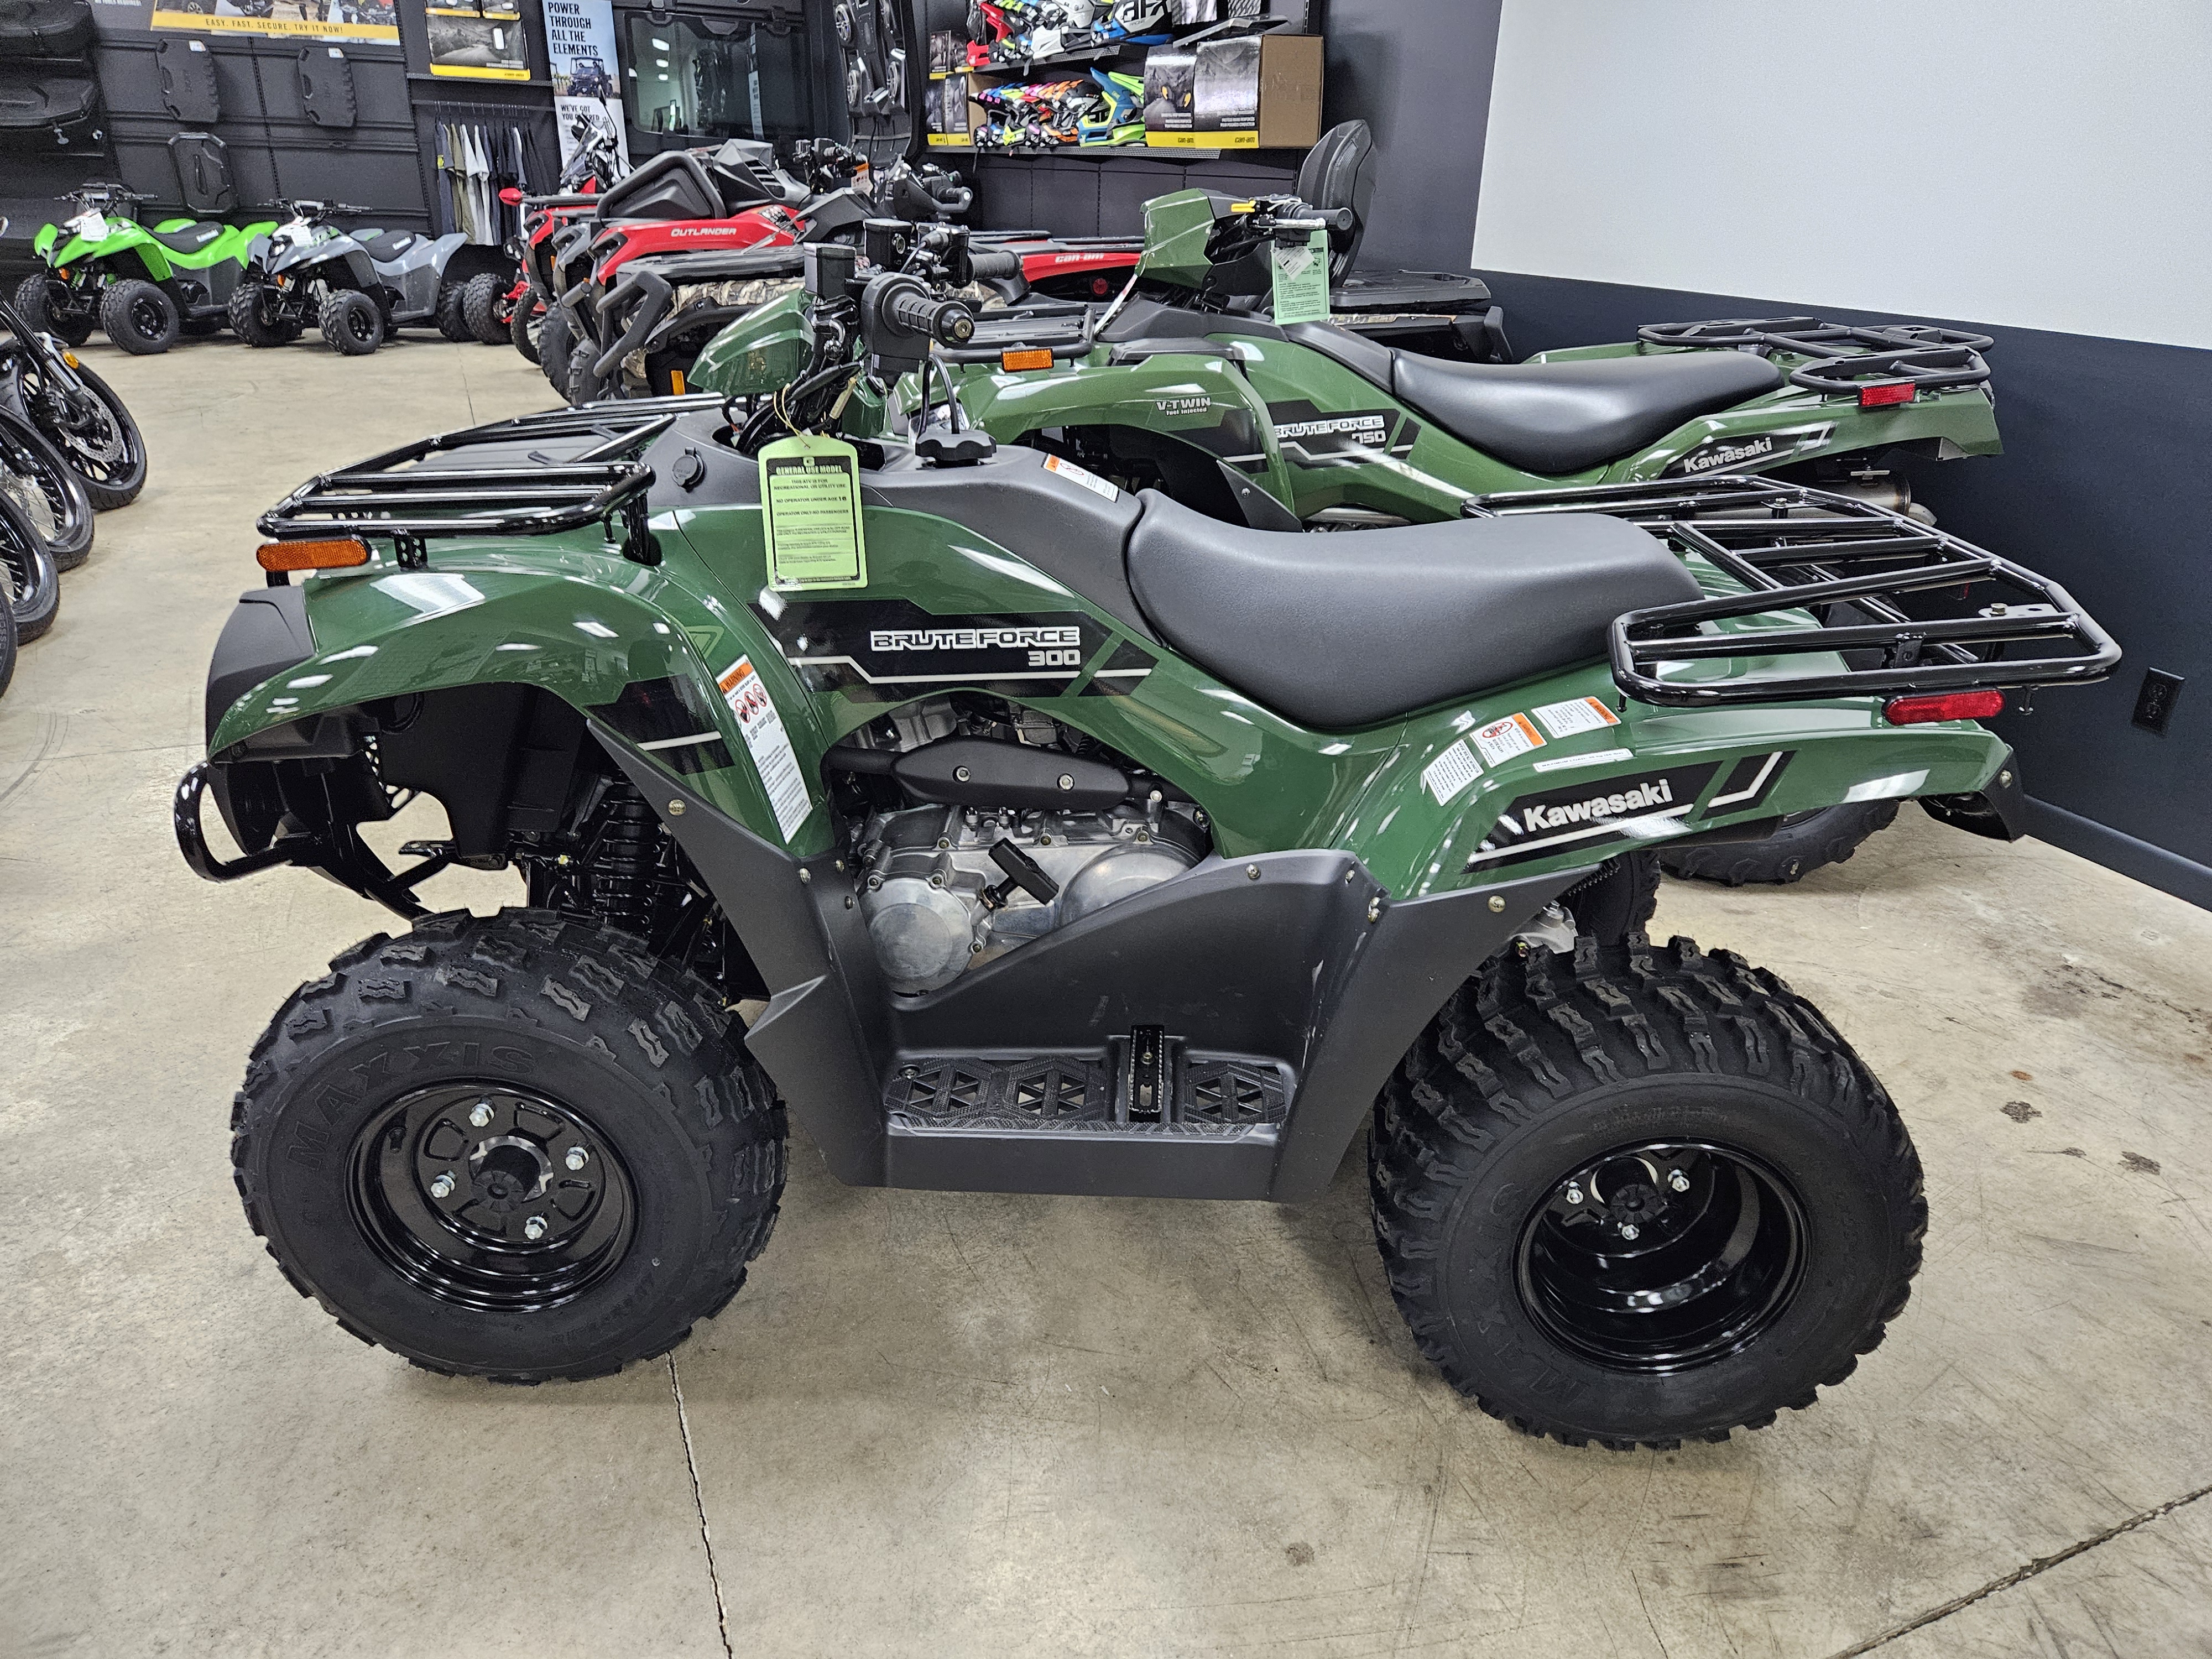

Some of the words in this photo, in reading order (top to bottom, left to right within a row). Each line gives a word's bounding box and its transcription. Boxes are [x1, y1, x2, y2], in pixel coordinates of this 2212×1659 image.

[548, 2, 580, 15] POWER
[206, 18, 228, 27] EASY.
[257, 22, 291, 30] SECURE.
[549, 15, 591, 29] THROUGH
[552, 29, 567, 41] ALL
[568, 30, 586, 43] THE
[553, 43, 598, 56] ELEMENTS
[561, 103, 578, 112] WE'VE
[671, 227, 737, 237] OUTLANDER
[1156, 397, 1211, 411] V-TWIN
[1352, 430, 1386, 444] 750
[1683, 437, 1773, 473] Kawasaki
[1027, 649, 1081, 666] 300
[724, 668, 745, 690] WARNING
[1523, 779, 1673, 832] Kawasaki
[285, 1042, 536, 1171] MAXXIS
